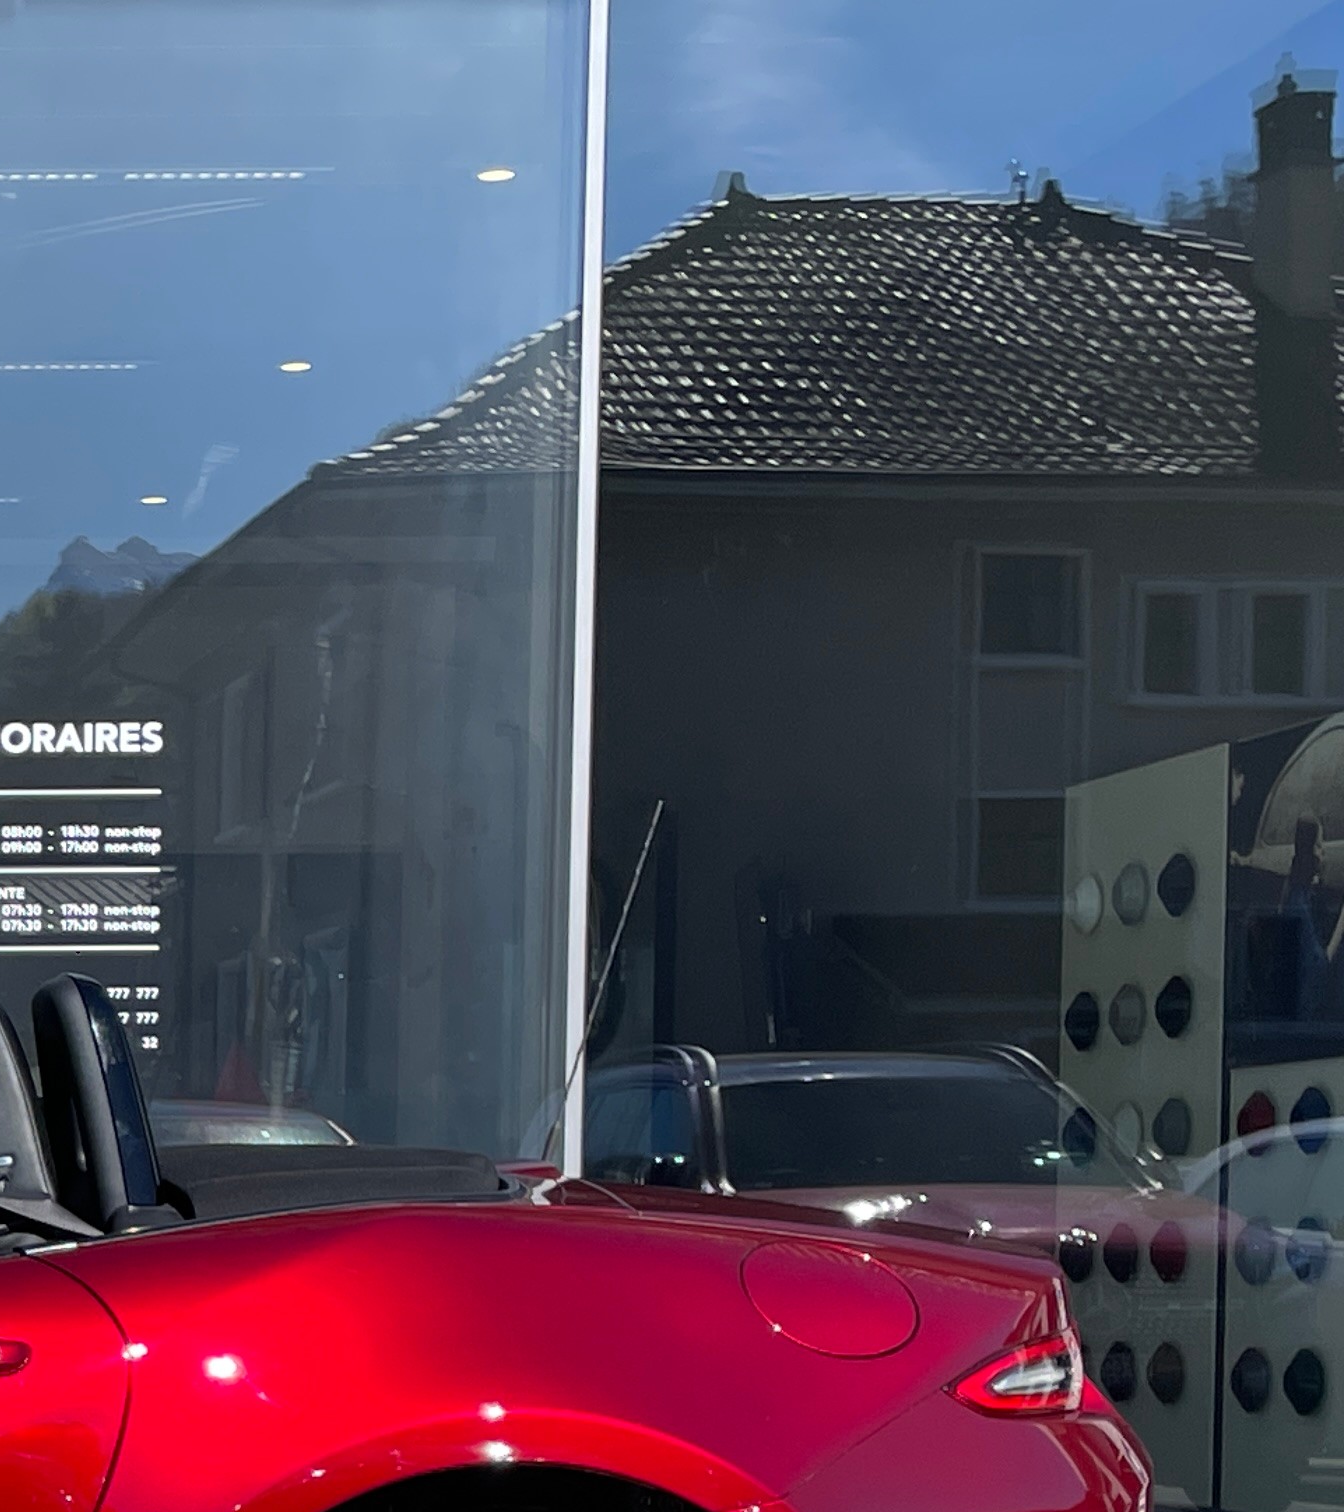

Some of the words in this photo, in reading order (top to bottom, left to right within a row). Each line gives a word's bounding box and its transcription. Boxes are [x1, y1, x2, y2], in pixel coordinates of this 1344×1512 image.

[59, 825, 100, 839] 18h30
[104, 826, 162, 841] non-stop
[0, 841, 43, 854] 09h00
[59, 841, 99, 854] 17h00
[104, 841, 161, 856] non-stop
[0, 903, 43, 917] 07h30
[59, 903, 99, 917] 17h30
[103, 904, 161, 918] non-stop
[0, 919, 43, 932] 07h30
[59, 919, 98, 932] 17h30
[103, 919, 160, 934] non-stop
[135, 986, 160, 1000] 777
[135, 1011, 160, 1025] 777
